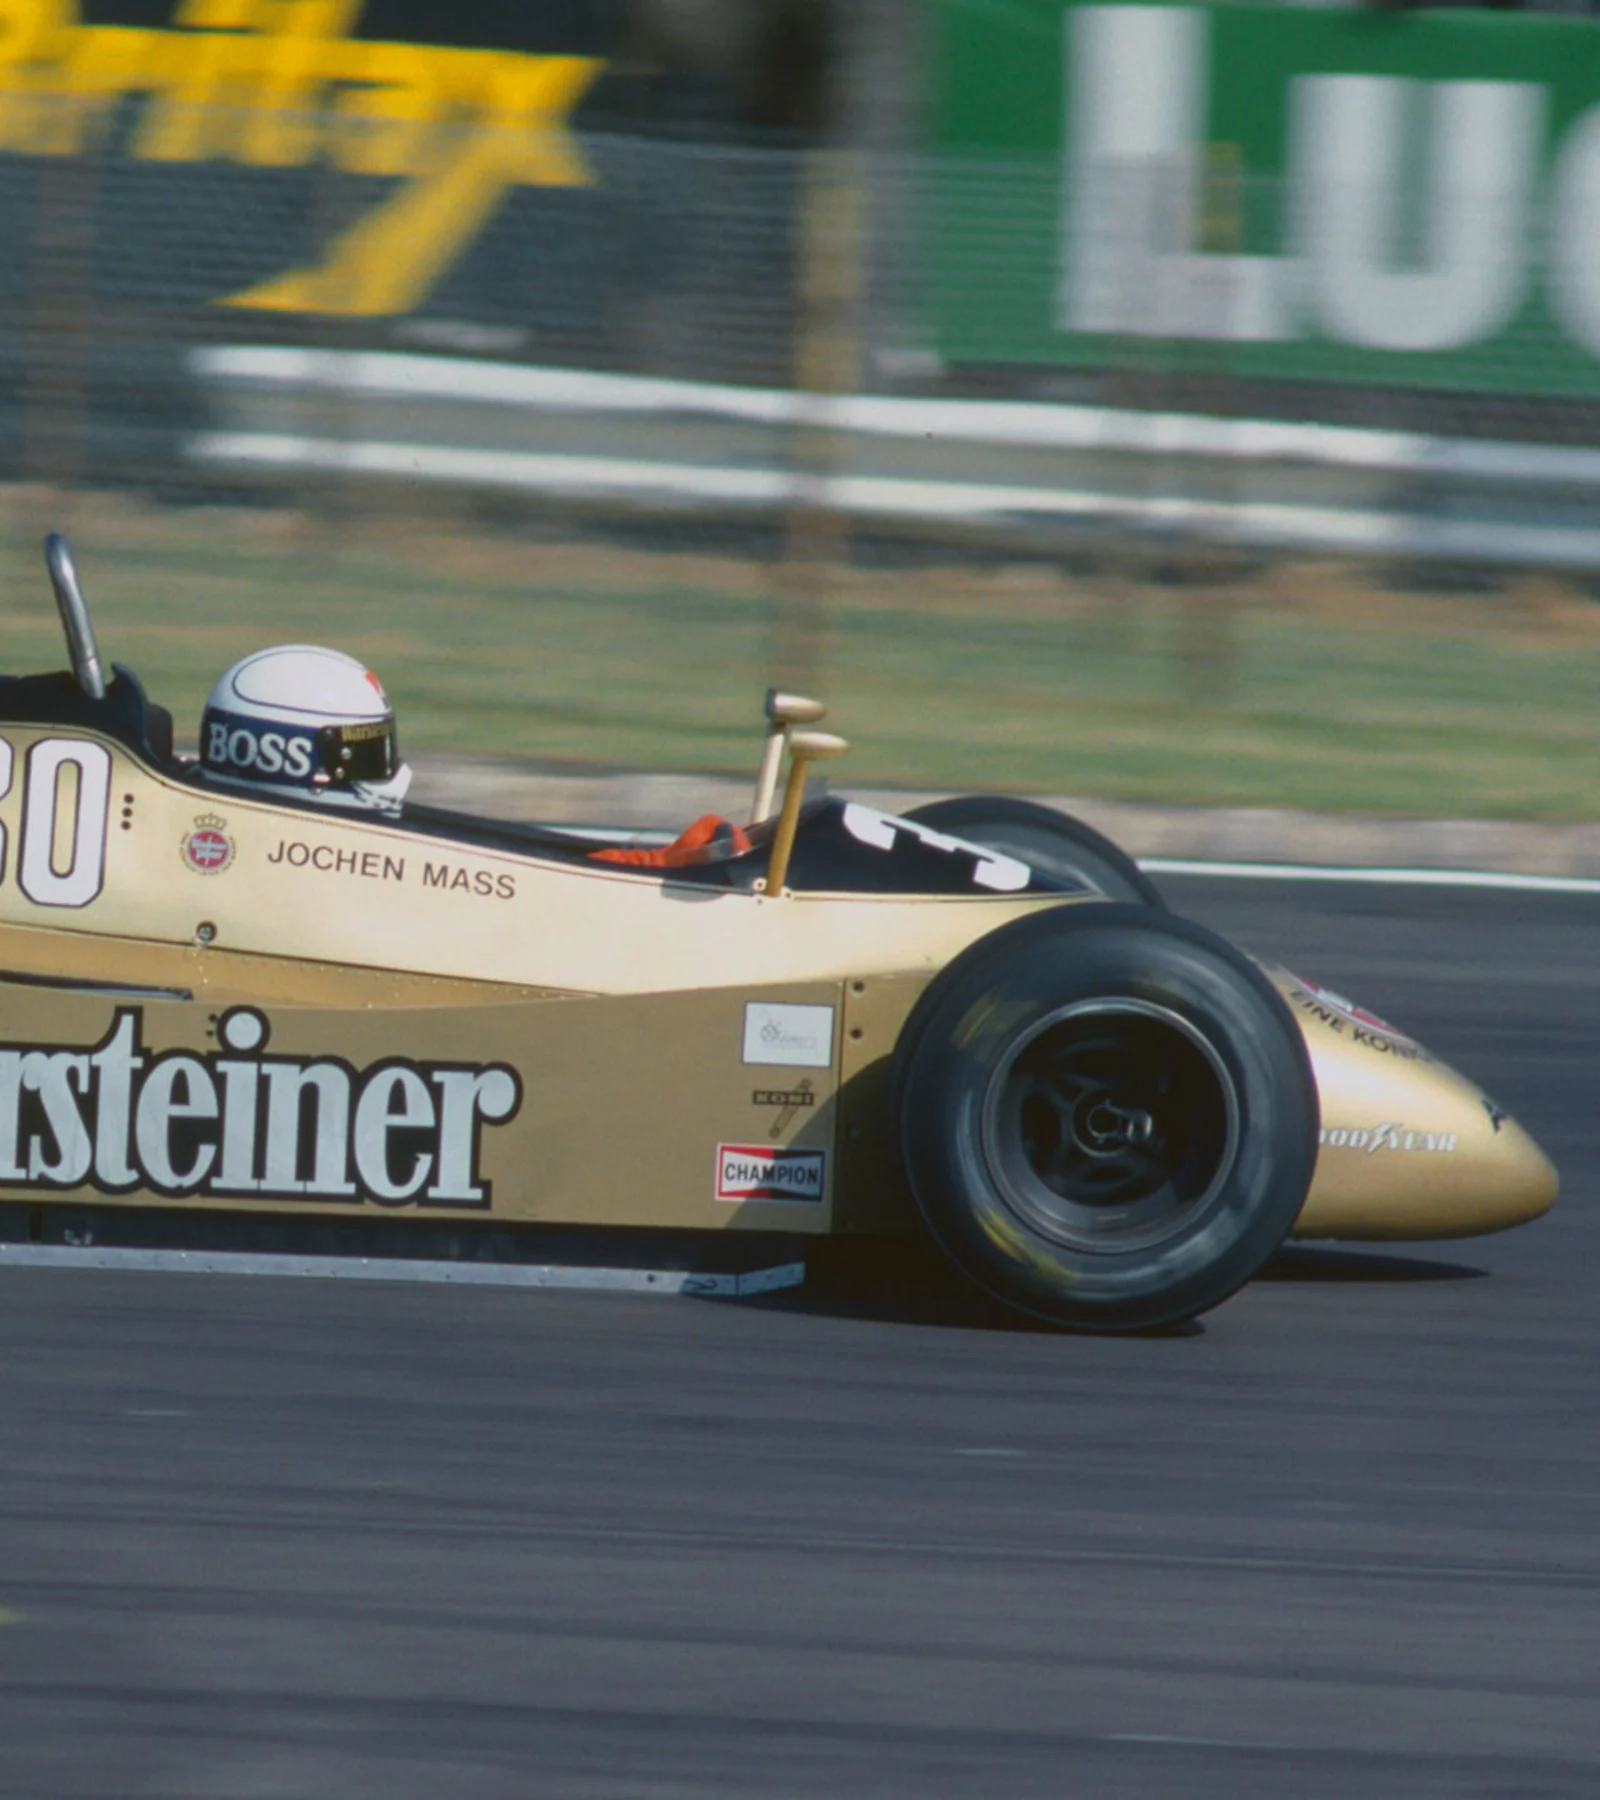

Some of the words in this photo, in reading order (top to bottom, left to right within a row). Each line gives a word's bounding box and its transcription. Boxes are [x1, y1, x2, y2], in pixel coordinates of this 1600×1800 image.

[207, 722, 312, 777] BOSS
[267, 841, 405, 881] JOCHEN
[423, 862, 516, 899] MASS
[724, 1162, 819, 1185] CHAMPION
